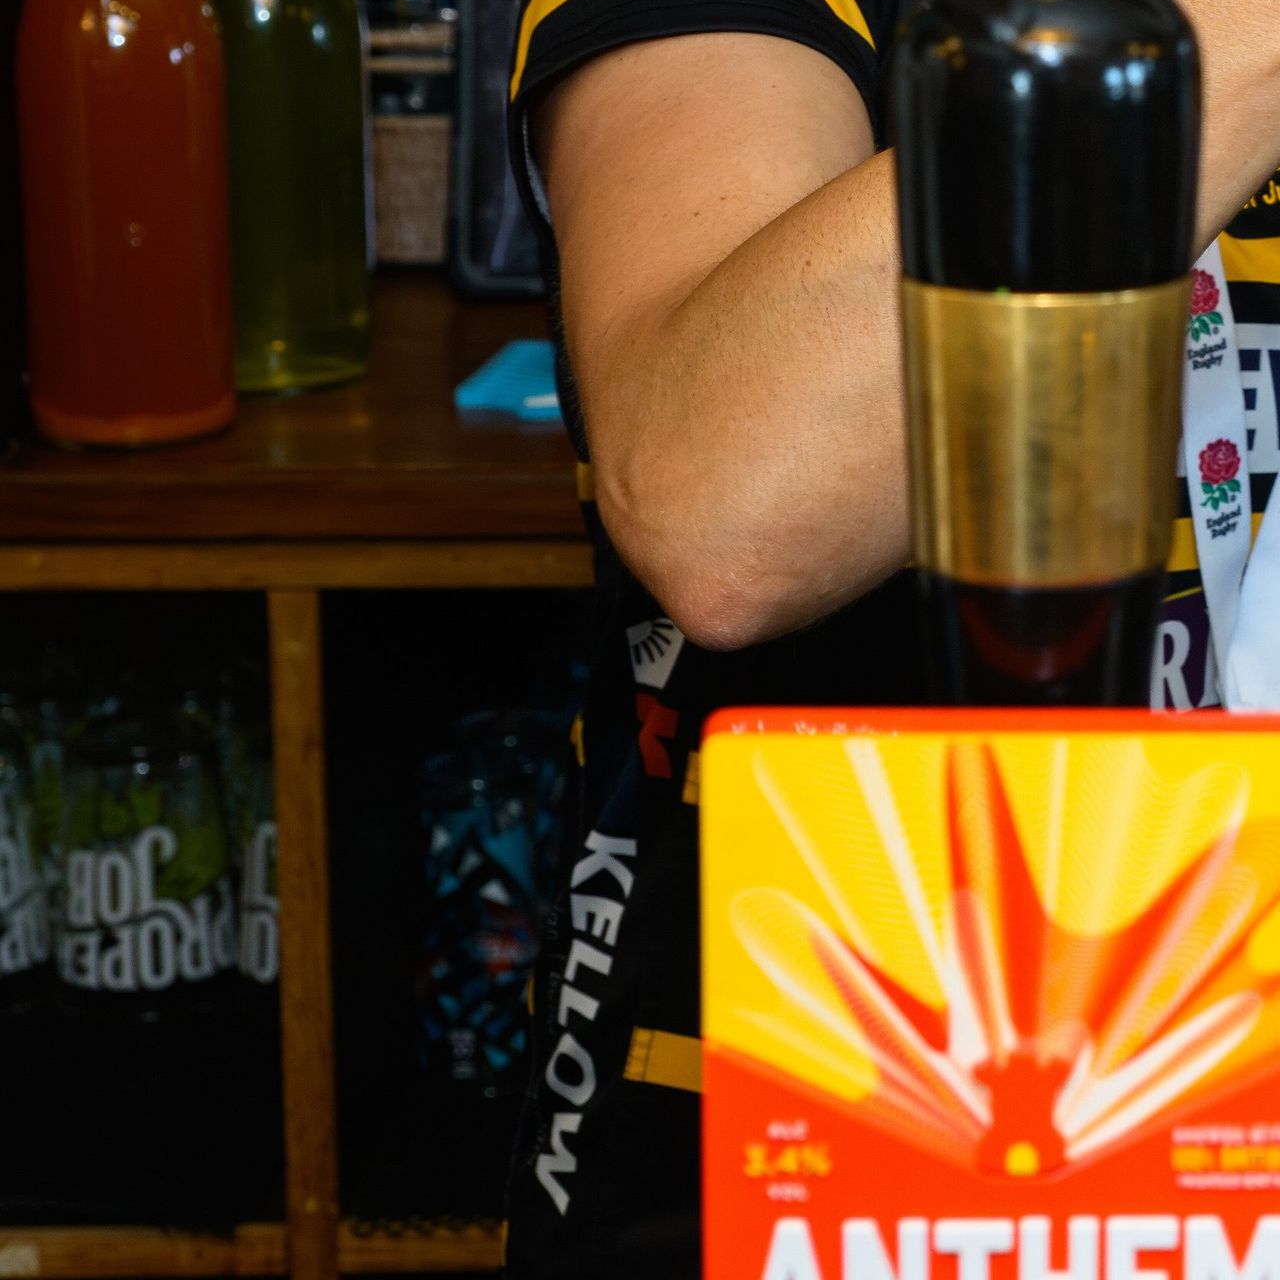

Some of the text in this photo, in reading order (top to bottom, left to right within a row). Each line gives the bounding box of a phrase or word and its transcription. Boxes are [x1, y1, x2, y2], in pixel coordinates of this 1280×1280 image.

[1187, 339, 1228, 361] England
[1192, 353, 1224, 372] Rugby
[535, 829, 639, 1217] KELLOW
[743, 1143, 831, 1177] 3.4%
